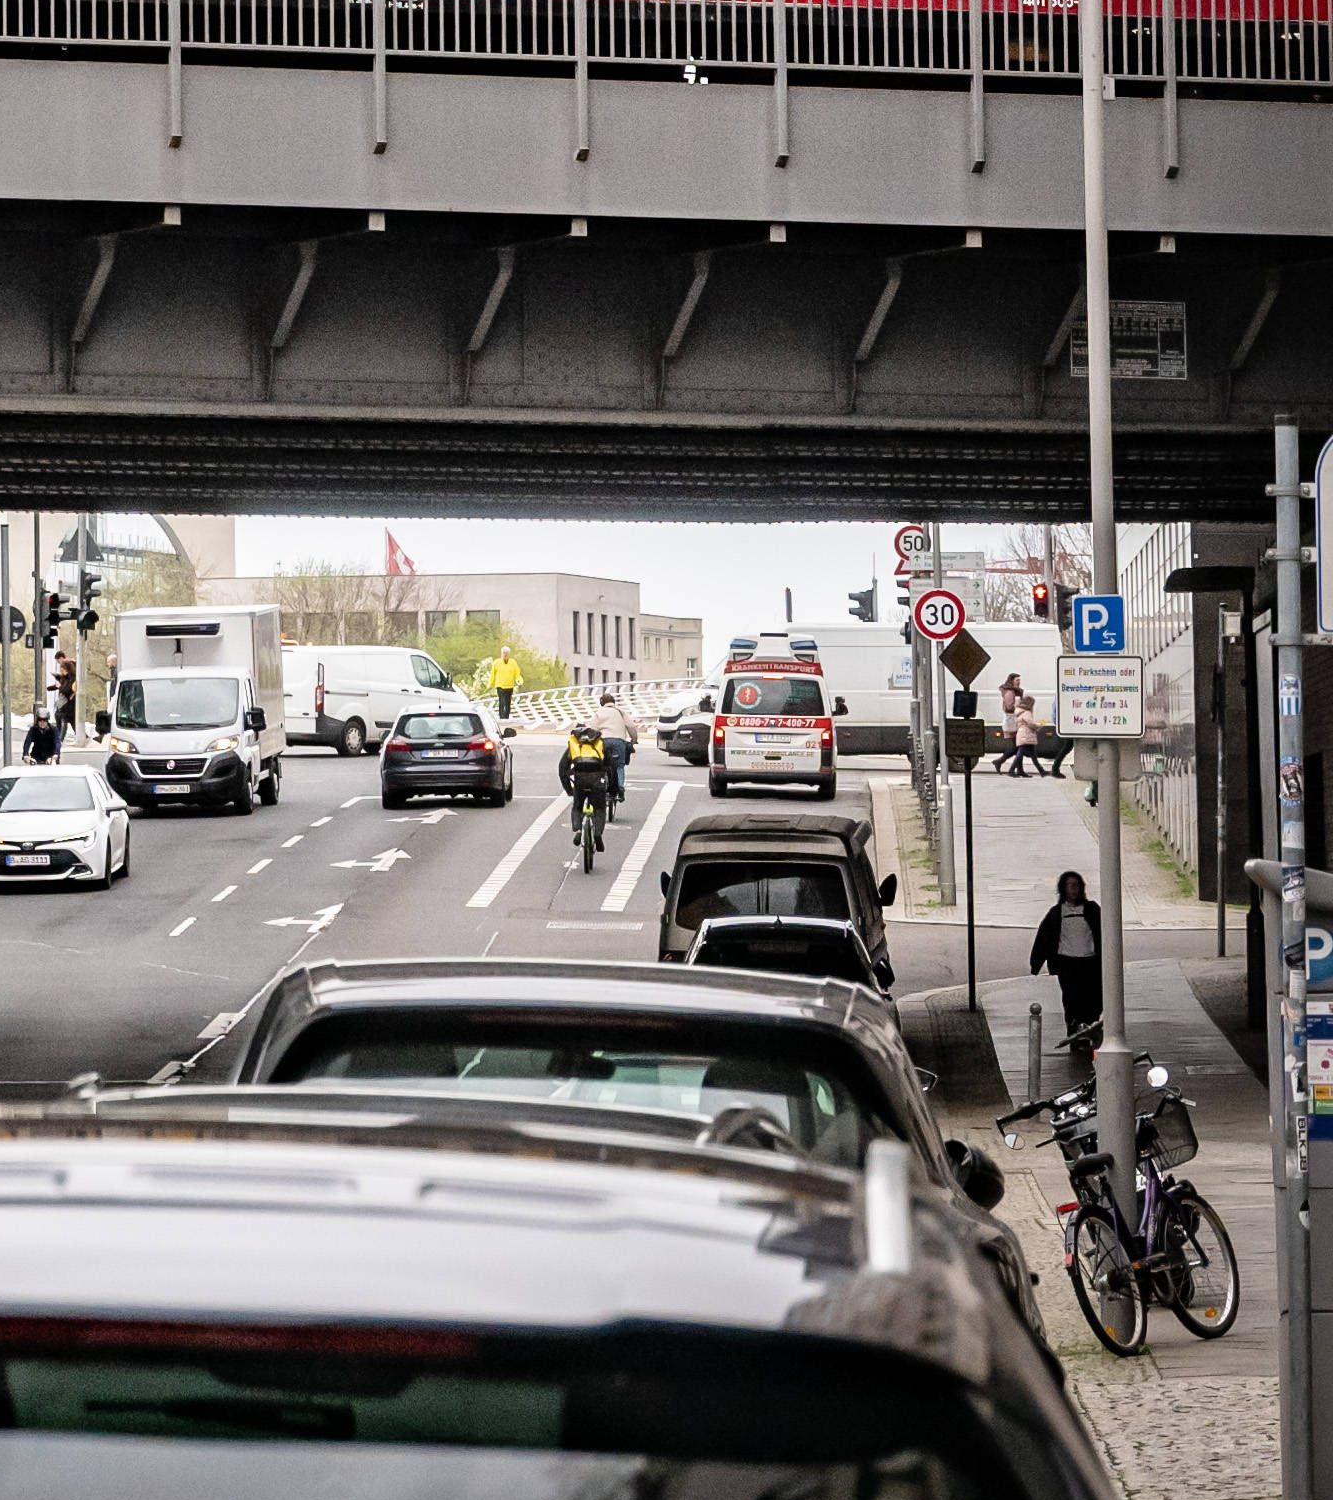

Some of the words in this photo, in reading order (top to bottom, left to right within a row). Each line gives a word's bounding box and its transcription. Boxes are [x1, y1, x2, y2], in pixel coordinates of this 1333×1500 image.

[903, 535, 924, 552] 50
[925, 603, 954, 626] 30
[1081, 603, 1109, 646] P
[1304, 927, 1333, 981] P
